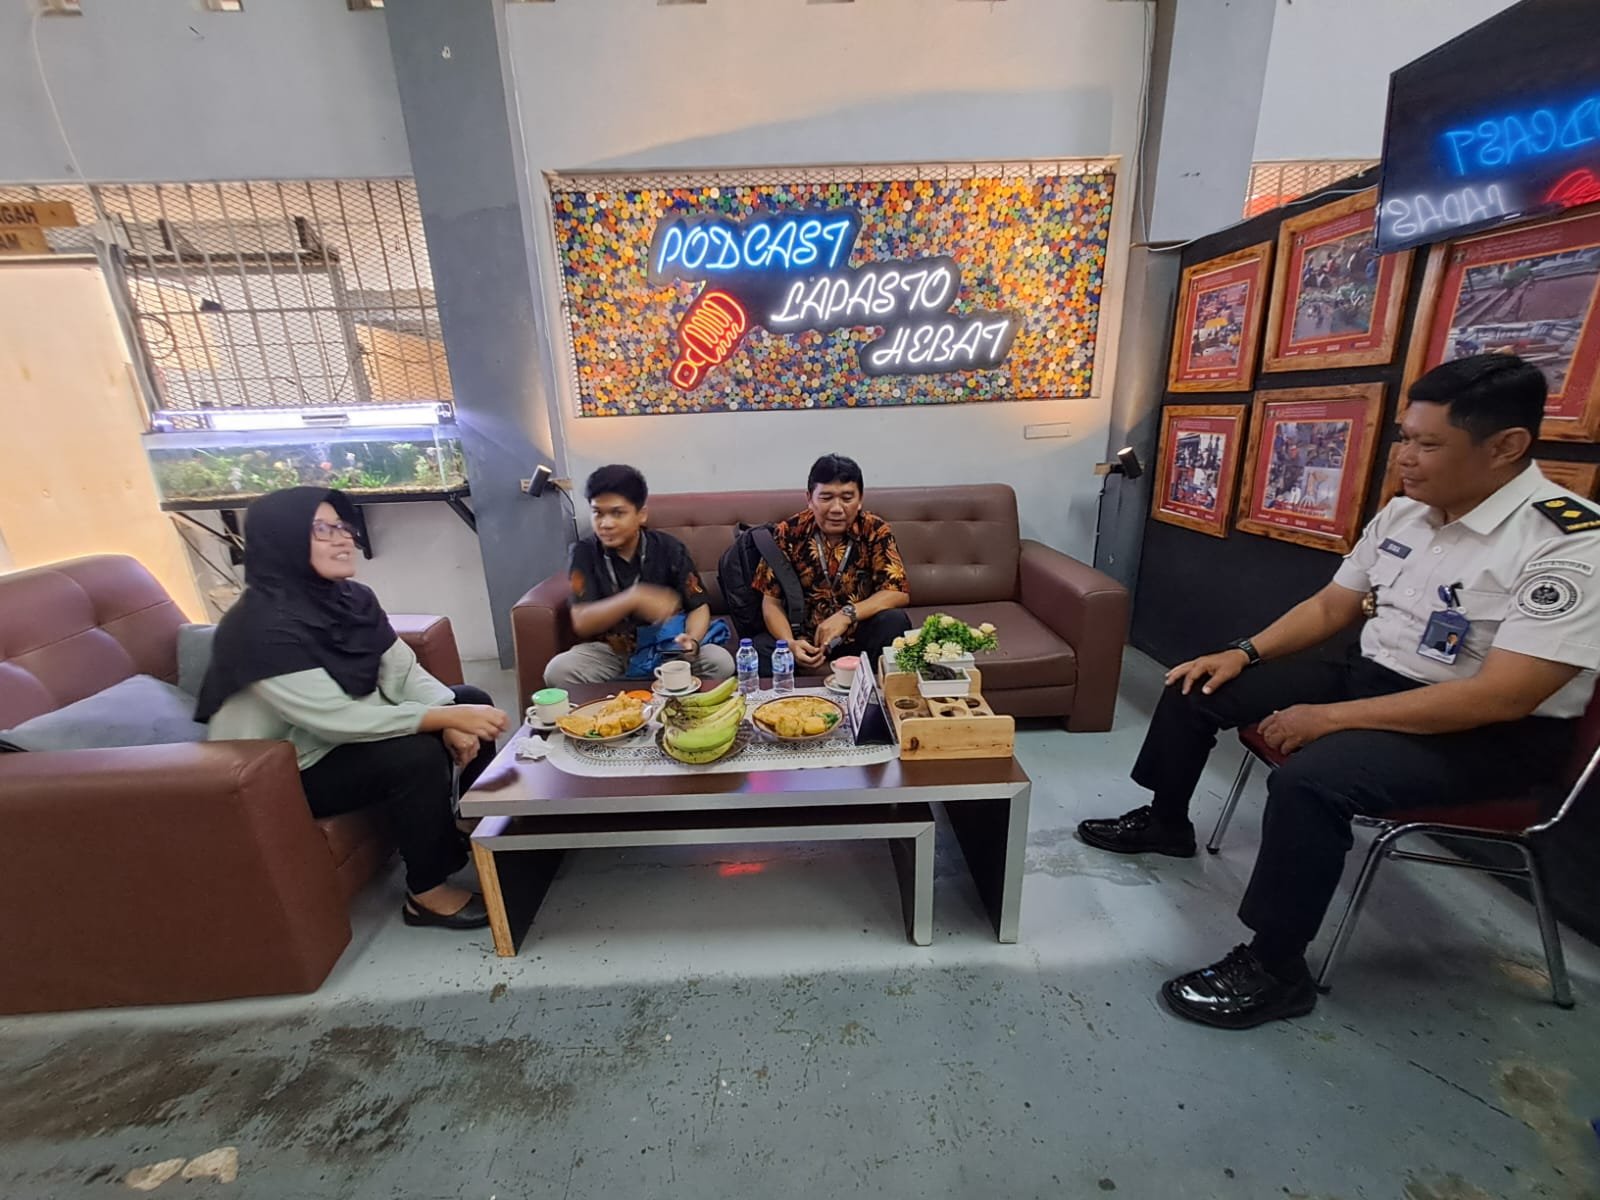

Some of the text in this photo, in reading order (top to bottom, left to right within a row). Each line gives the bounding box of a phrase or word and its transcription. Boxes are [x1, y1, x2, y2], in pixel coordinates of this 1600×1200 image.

[0, 204, 40, 226] GAH
[657, 219, 850, 275] PODCAST
[871, 318, 1011, 366] HEBAT
